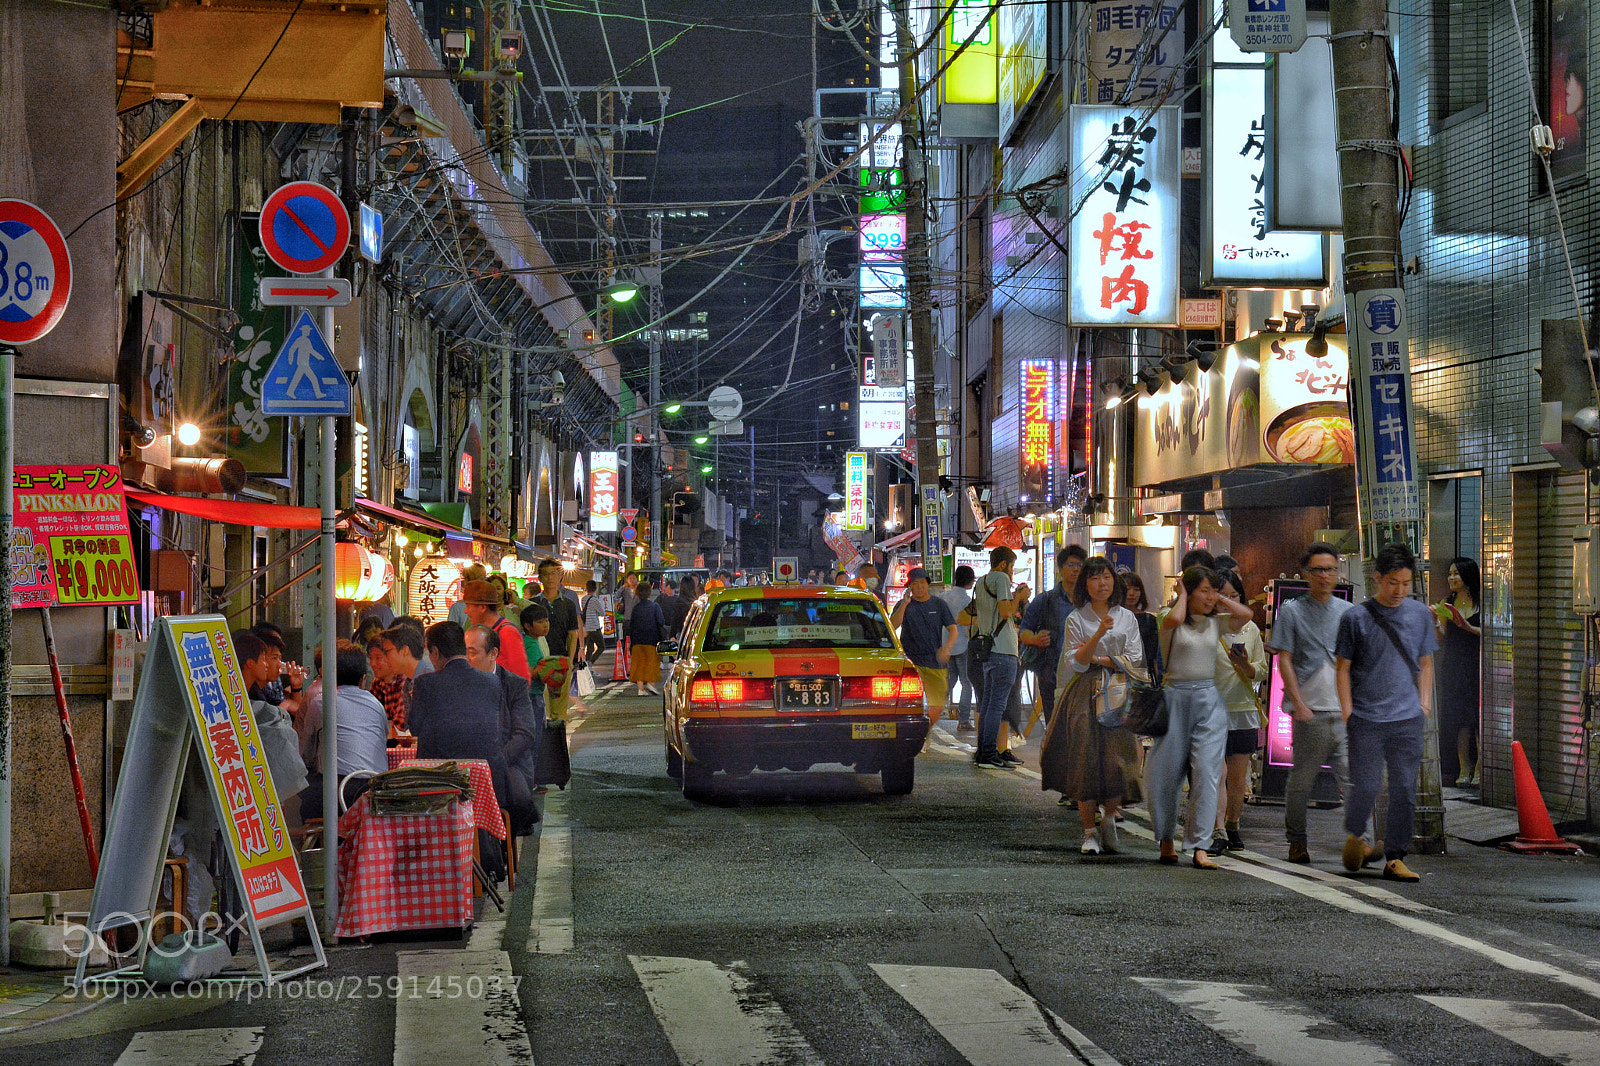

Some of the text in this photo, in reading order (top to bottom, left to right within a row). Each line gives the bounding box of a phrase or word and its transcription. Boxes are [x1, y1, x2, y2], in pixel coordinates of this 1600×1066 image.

[1245, 34, 1293, 45] 3504-2070
[1092, 115, 1158, 315] 炭火焼肉
[1185, 302, 1217, 312] 入口は
[1366, 299, 1400, 333] 質
[1375, 378, 1406, 480] セキネ
[18, 493, 122, 512] PINKSALON
[593, 471, 616, 514] 王将
[850, 456, 863, 525] 無料案内所
[62, 538, 121, 556] 只今の料金
[55, 558, 135, 600] ¥9,000
[183, 636, 267, 859] 無料案内所
[216, 631, 283, 851] キャバクラ フーゾク
